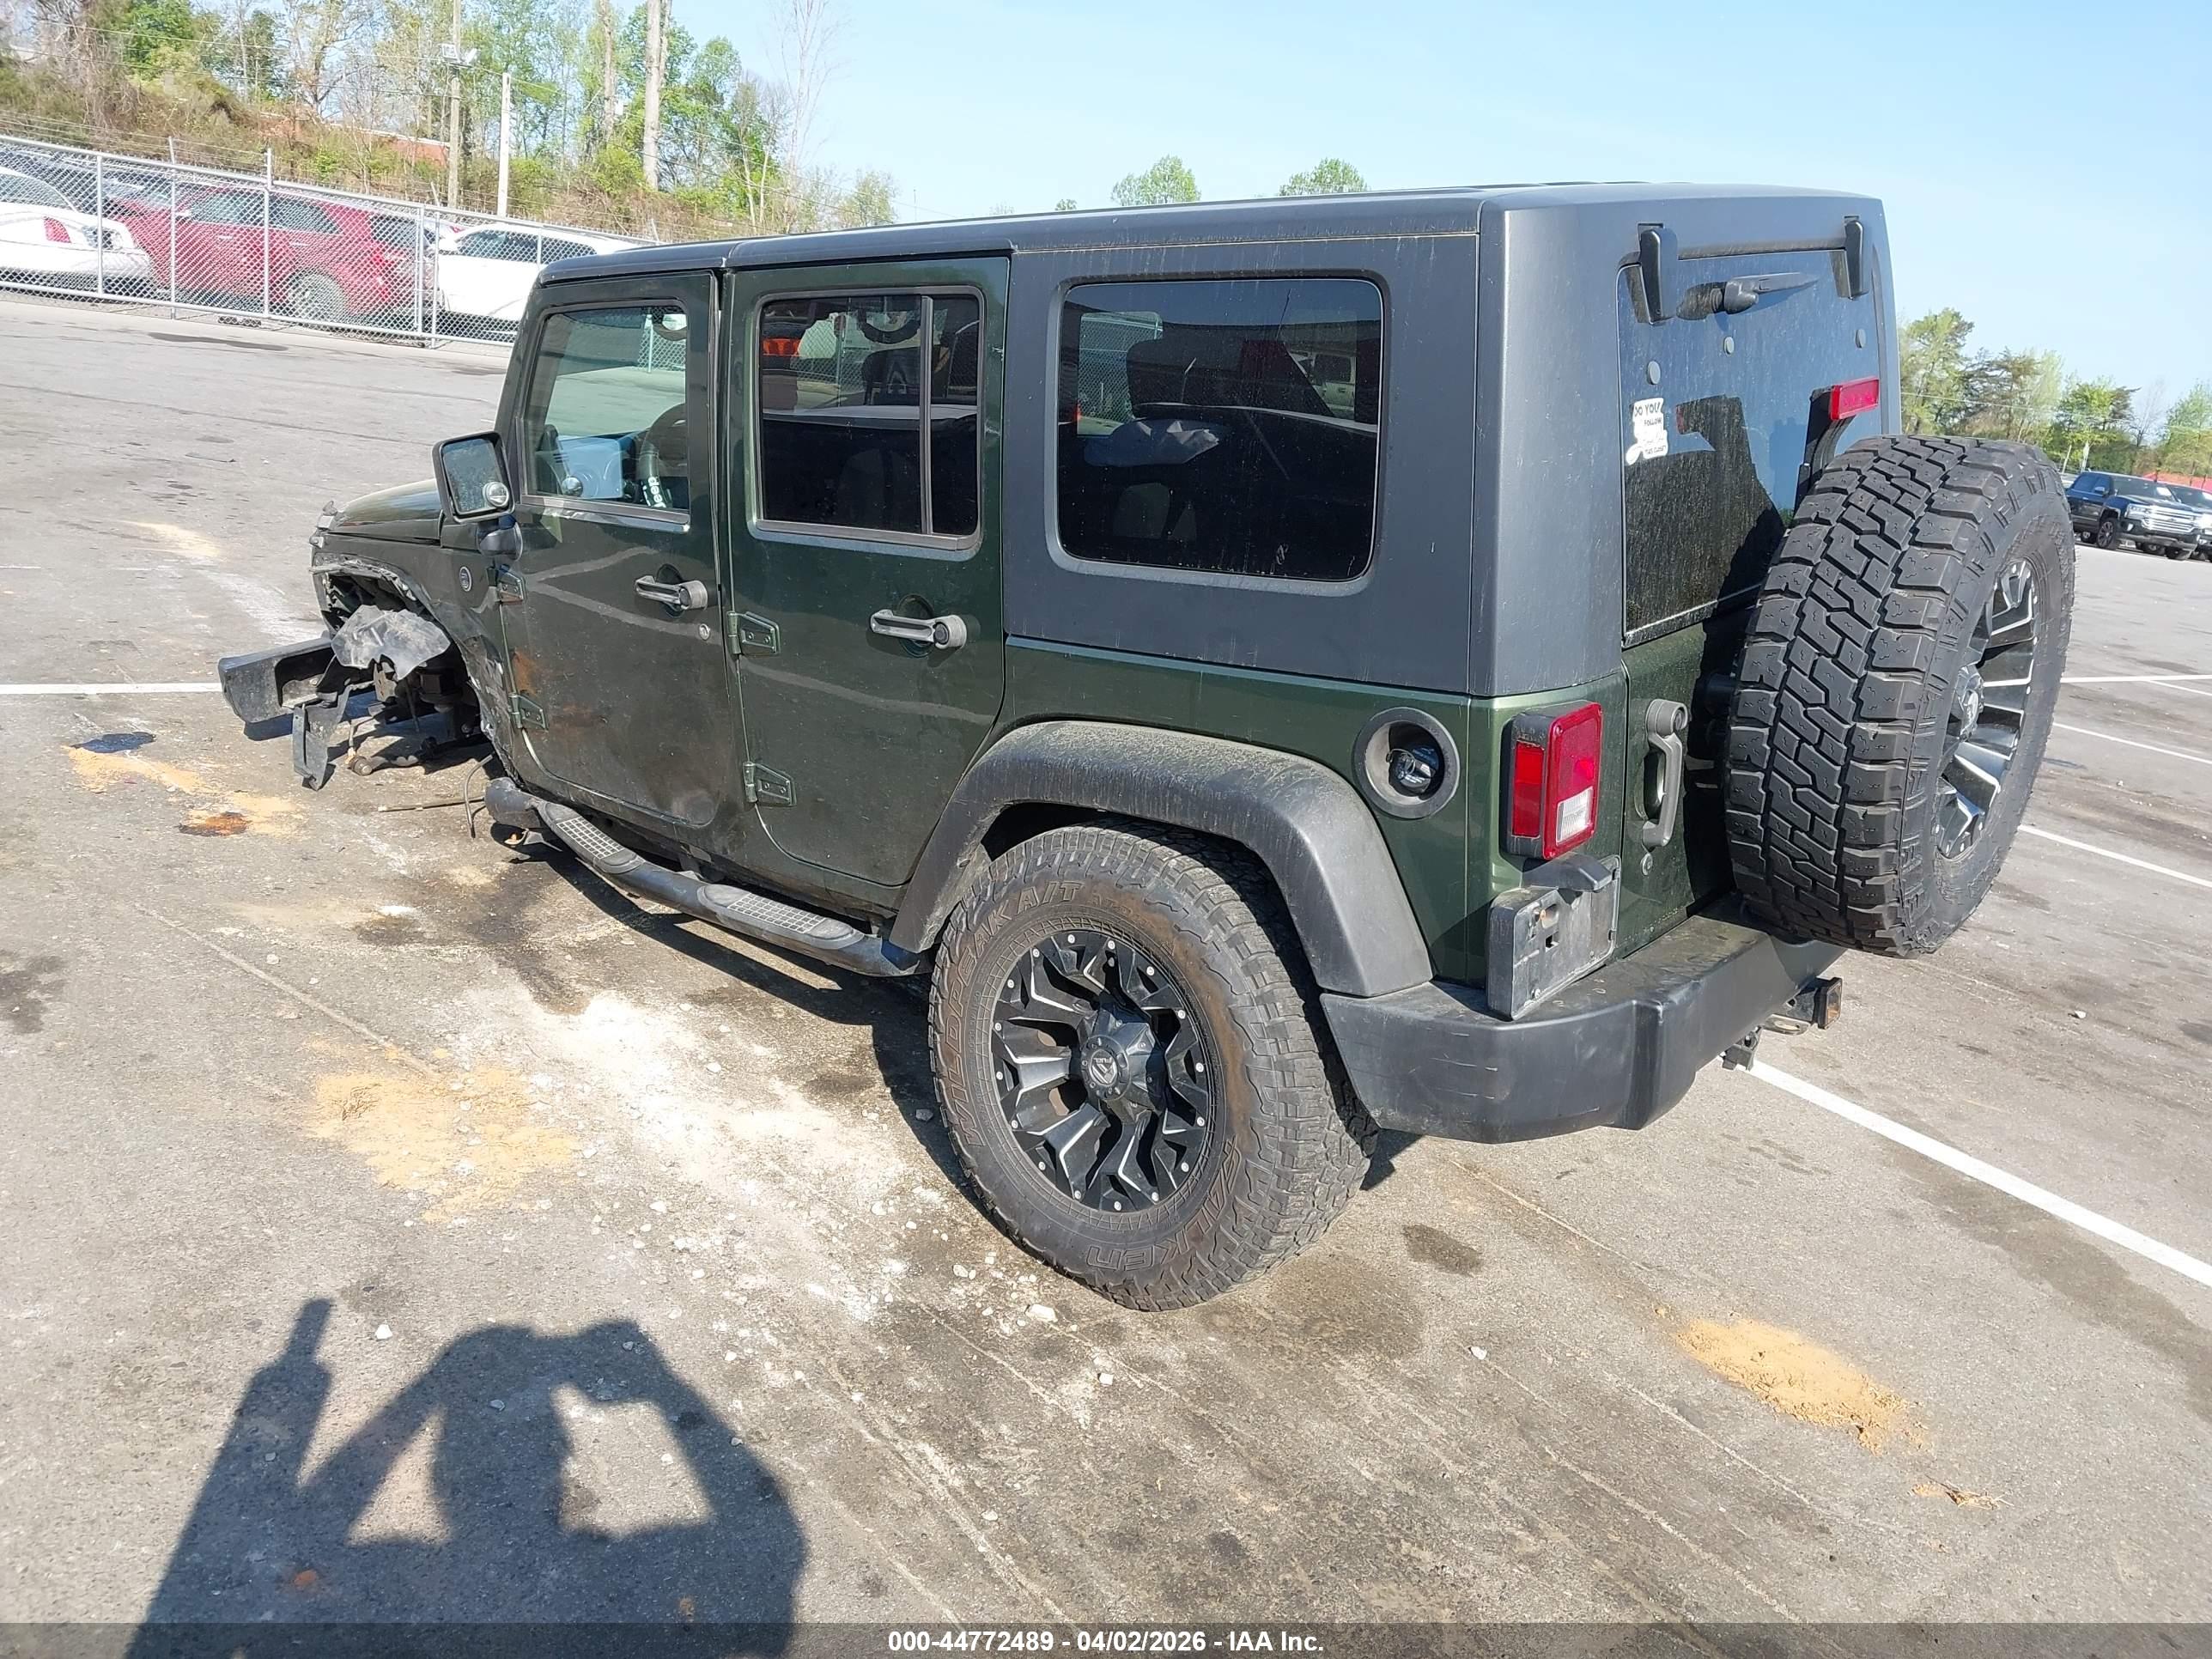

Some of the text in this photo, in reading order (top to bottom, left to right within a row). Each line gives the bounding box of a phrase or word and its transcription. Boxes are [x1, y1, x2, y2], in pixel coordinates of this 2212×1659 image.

[1644, 417, 1662, 426] FOLLOW
[945, 899, 1012, 1146] WILDPEAK
[1017, 880, 1085, 915] A/T
